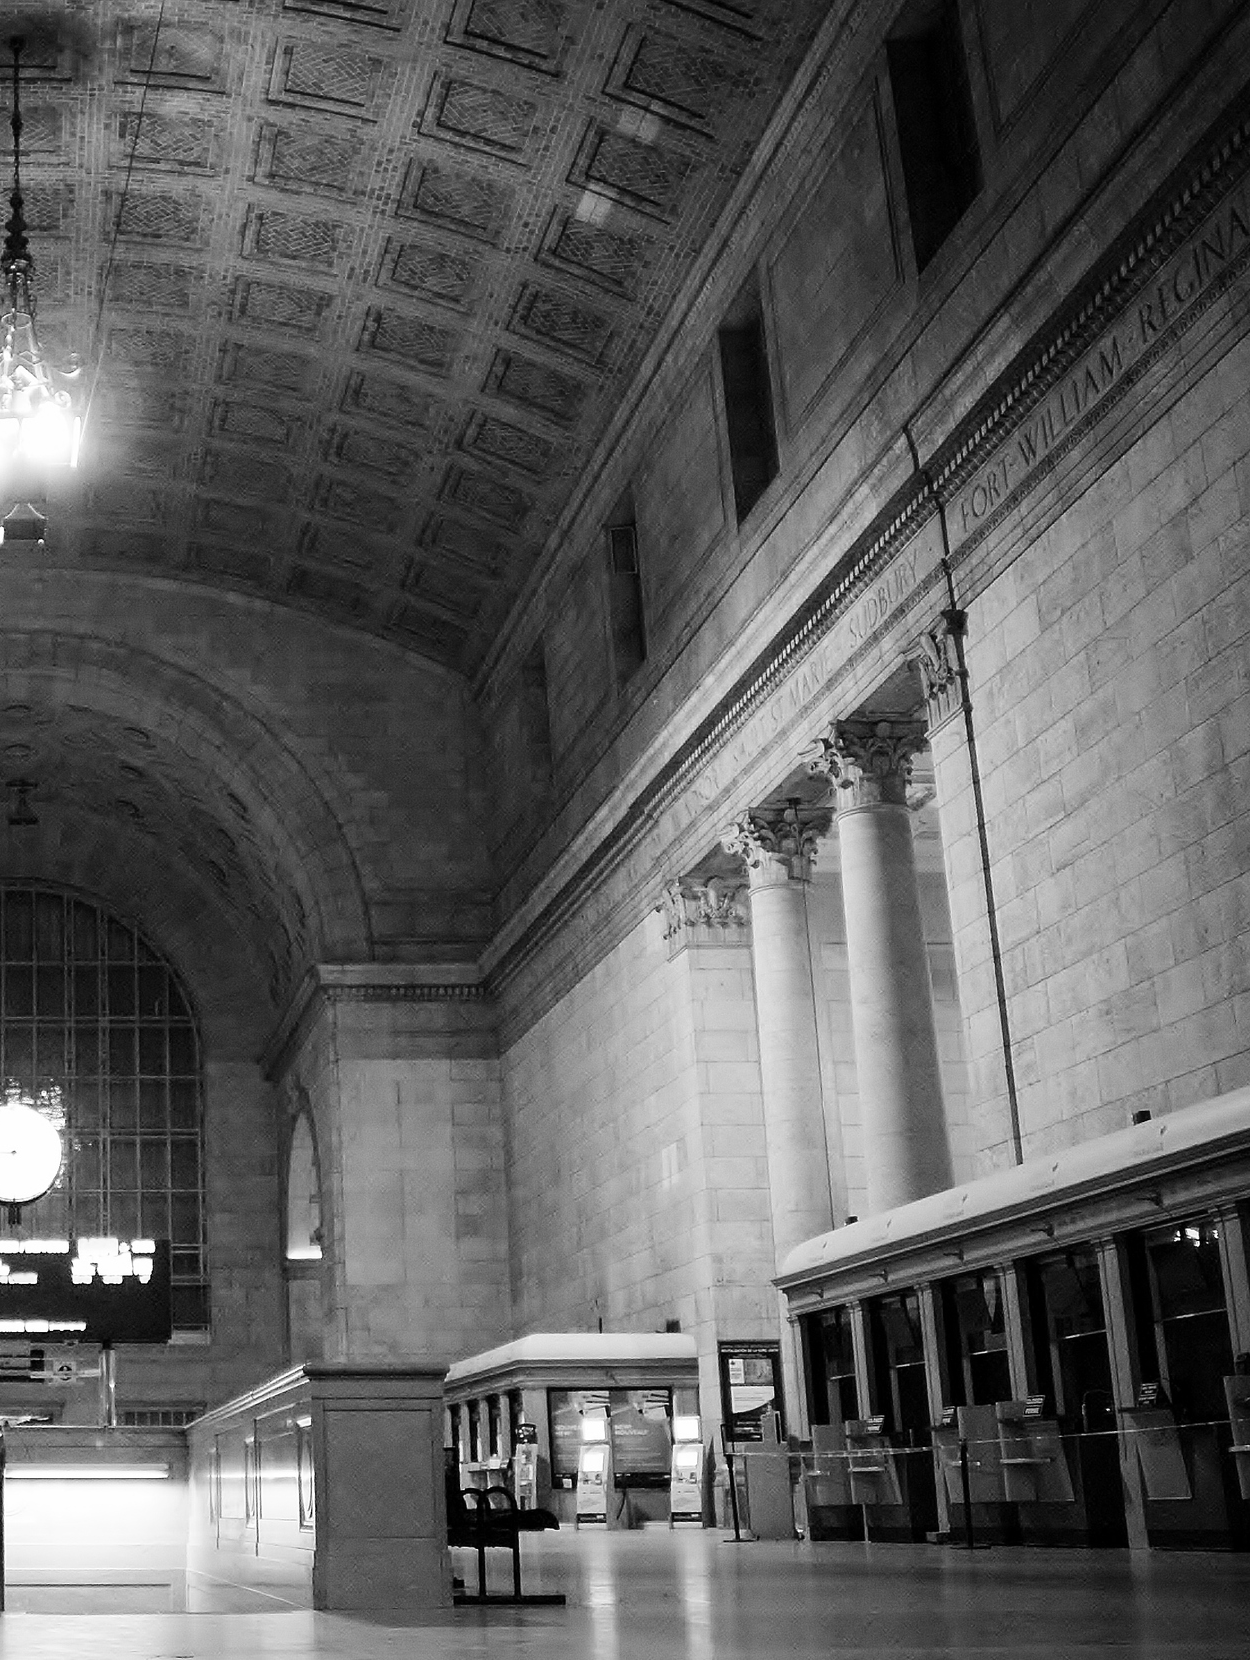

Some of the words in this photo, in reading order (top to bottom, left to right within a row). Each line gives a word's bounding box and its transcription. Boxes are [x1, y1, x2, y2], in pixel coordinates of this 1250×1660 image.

[848, 549, 921, 649] SUDBURY
[961, 458, 1009, 533] FORT
[1017, 336, 1123, 467] WILLIAM
[1138, 206, 1250, 343] REGINA
